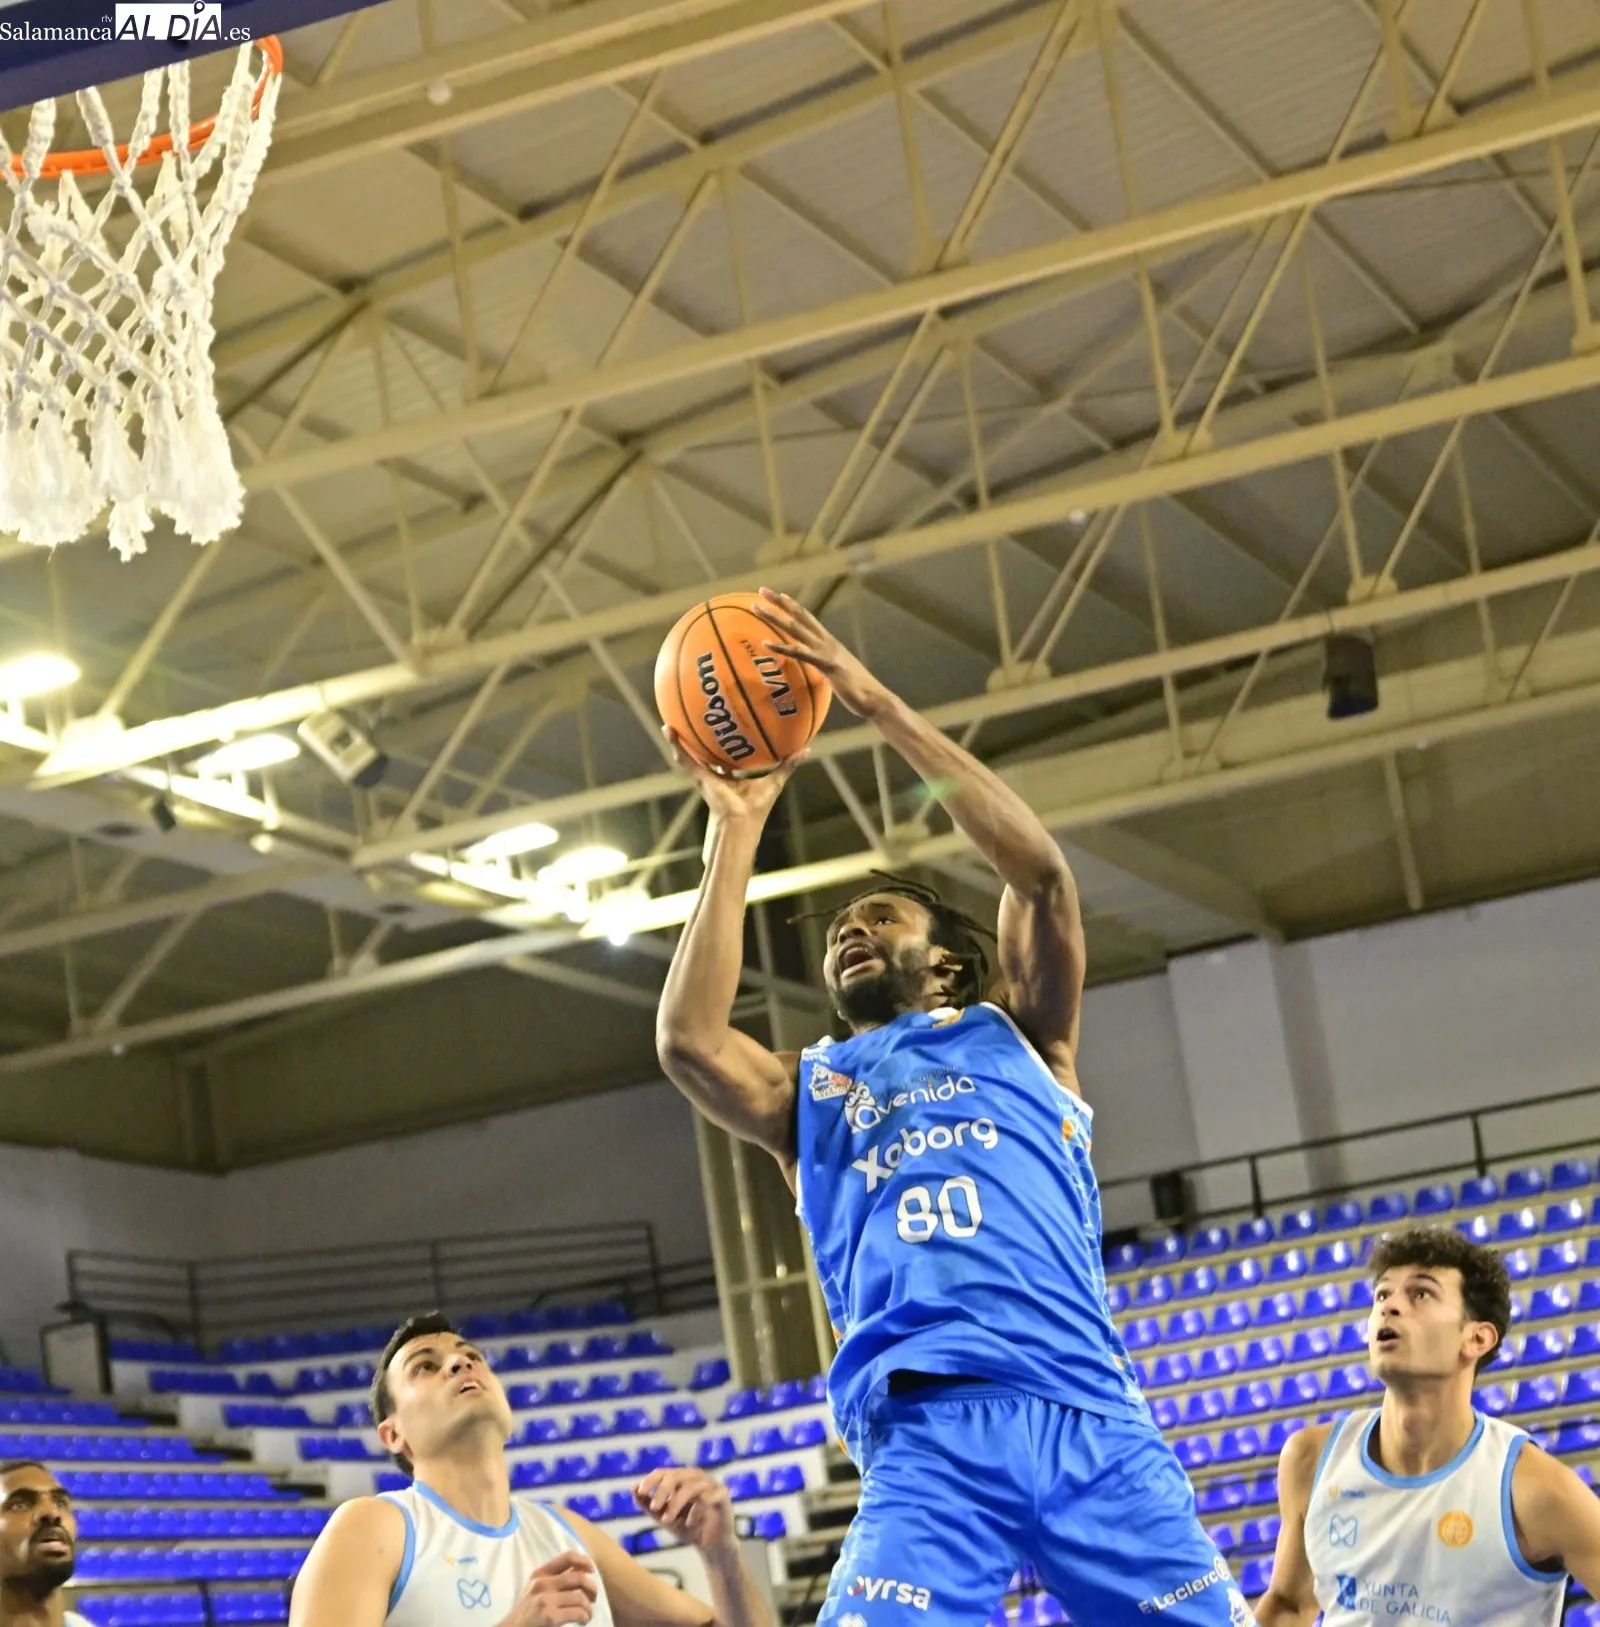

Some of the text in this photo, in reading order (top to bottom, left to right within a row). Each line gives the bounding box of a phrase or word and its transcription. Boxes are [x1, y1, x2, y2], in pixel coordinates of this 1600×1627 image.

[697, 652, 756, 761] Wilson
[896, 1175, 983, 1243] 80
[1359, 1598, 1452, 1624] DE GALICIA
[1361, 1580, 1420, 1599] XUNTA
